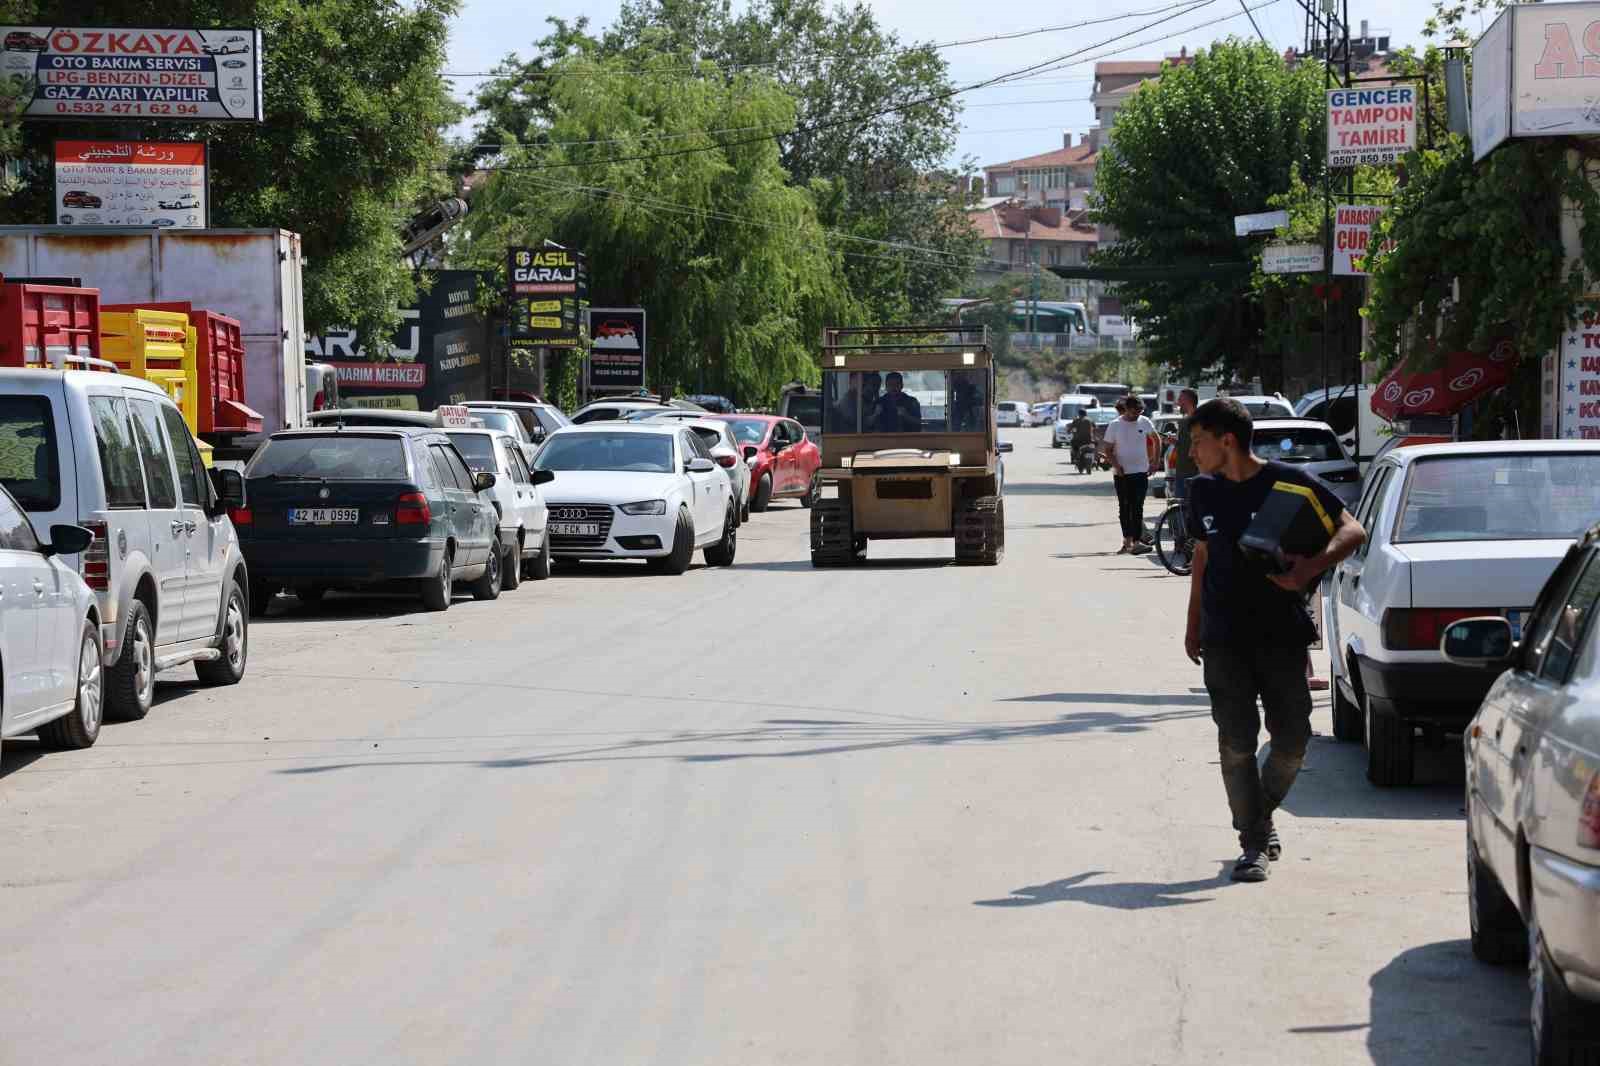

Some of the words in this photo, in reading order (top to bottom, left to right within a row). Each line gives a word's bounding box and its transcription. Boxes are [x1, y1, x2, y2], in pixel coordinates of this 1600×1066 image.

[52, 29, 200, 54] ÖZKAYA
[52, 57, 87, 68] OTO
[92, 57, 142, 69] BAKIM
[44, 86, 82, 99] GAZ
[86, 87, 137, 100] AYARI
[143, 88, 209, 101] YAPILIR
[1331, 89, 1412, 107] GENCER
[56, 102, 105, 113] 0.532
[111, 103, 142, 114] 471
[150, 103, 171, 114] 62
[177, 103, 199, 114] 94
[1331, 106, 1413, 126] TAMPON
[1338, 123, 1406, 146] TAMİRİ
[1333, 155, 1357, 165] 0507
[1360, 154, 1379, 163] 850
[514, 268, 576, 281] GARAJ
[335, 367, 374, 383] NARIM
[375, 366, 424, 383] MERKEZİ
[449, 417, 466, 425] OTO
[295, 510, 308, 521] 42
[330, 510, 358, 521] 0996
